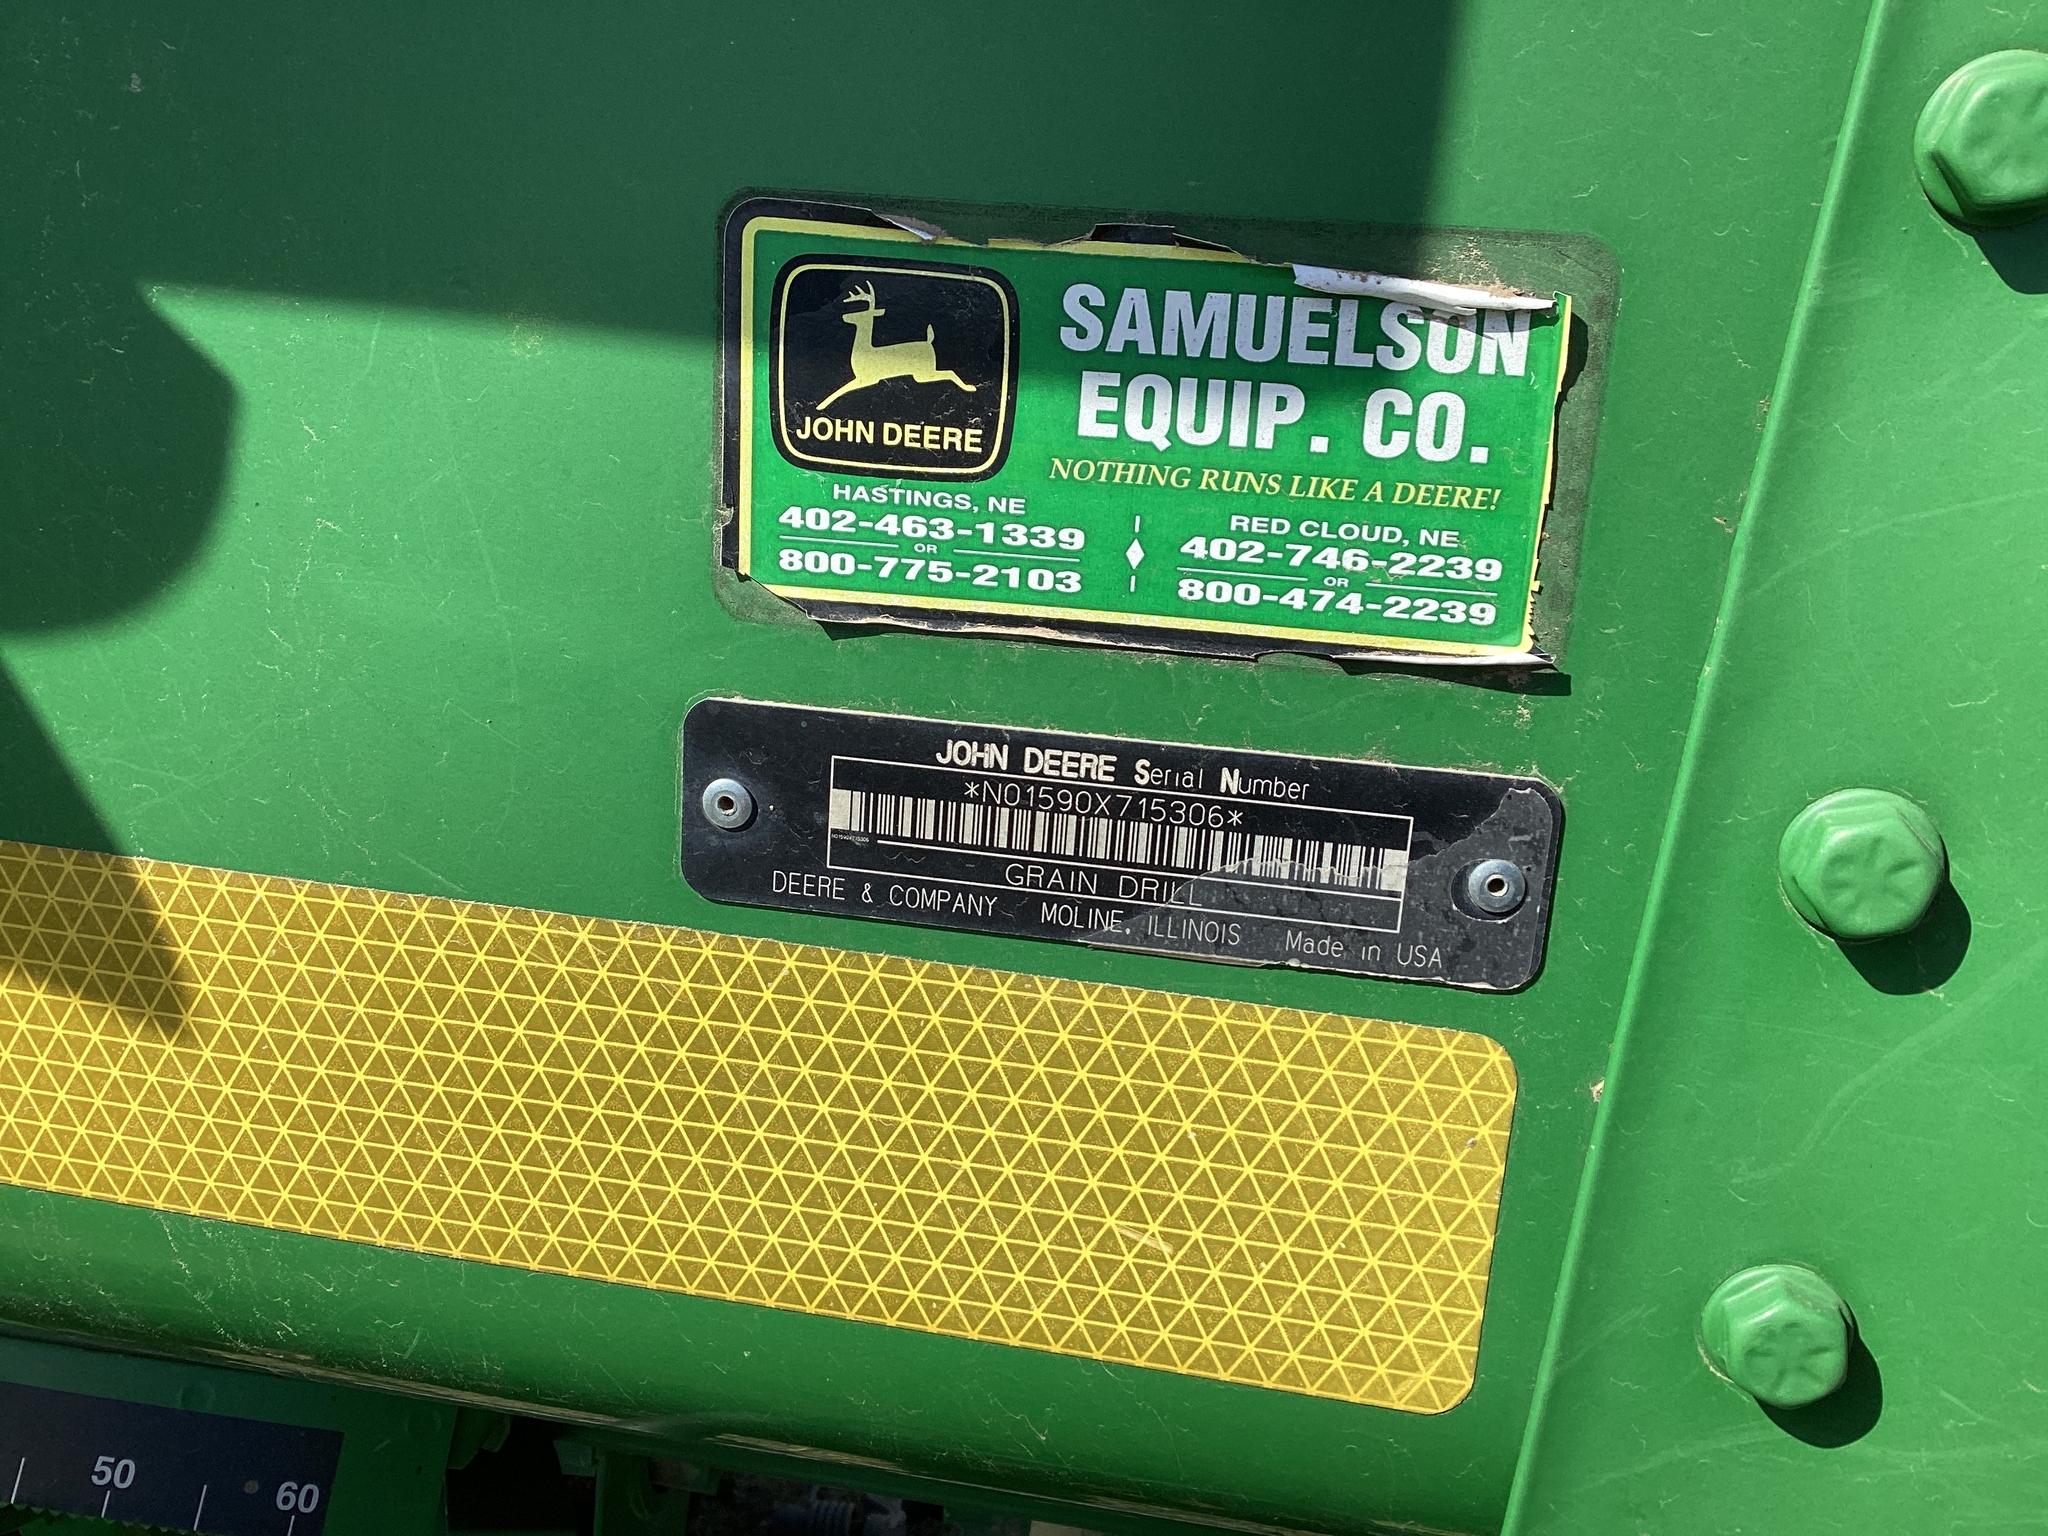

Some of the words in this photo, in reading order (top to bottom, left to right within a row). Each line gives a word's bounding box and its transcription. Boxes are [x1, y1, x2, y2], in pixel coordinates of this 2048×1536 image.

[1060, 282, 1531, 377] SAMUELSON
[796, 416, 875, 444] JOHN
[882, 423, 983, 453] DEERE
[1362, 388, 1489, 464] CO.
[833, 484, 979, 513] HASTINGS,
[988, 496, 1026, 515] NE
[1049, 457, 1191, 489] NOTHING
[1198, 468, 1282, 497] RUNS
[1289, 475, 1356, 501] LIKE
[1362, 480, 1387, 502] A
[1388, 485, 1502, 511] DEERE!
[778, 506, 1085, 551] 402-463-1339
[914, 543, 938, 554] OR
[1230, 515, 1291, 535] RED
[1300, 520, 1409, 547] CLOUD,
[1419, 529, 1460, 548] NE
[778, 549, 1082, 593] 800-775-2103
[1180, 536, 1503, 582] 402-746-2239
[1177, 578, 1497, 626] 800-474-2239
[1324, 576, 1349, 588] OR
[936, 739, 1009, 771] JOHN
[1023, 746, 1117, 782] DEERE
[1133, 759, 1204, 789] Serial
[1220, 767, 1310, 801] Number
[1005, 863, 1098, 895] GRAIN
[1118, 875, 1203, 906] DRILL
[772, 870, 846, 900] DEERE
[861, 884, 874, 904] &
[889, 884, 998, 917] COMPANY
[1041, 902, 1131, 935] MOLINE,
[1148, 914, 1242, 946] ILLINOIS
[1285, 930, 1344, 958] Made
[1361, 945, 1381, 962] in
[1397, 943, 1443, 968] USA
[91, 1455, 136, 1489] 50
[275, 1481, 320, 1514] 60
